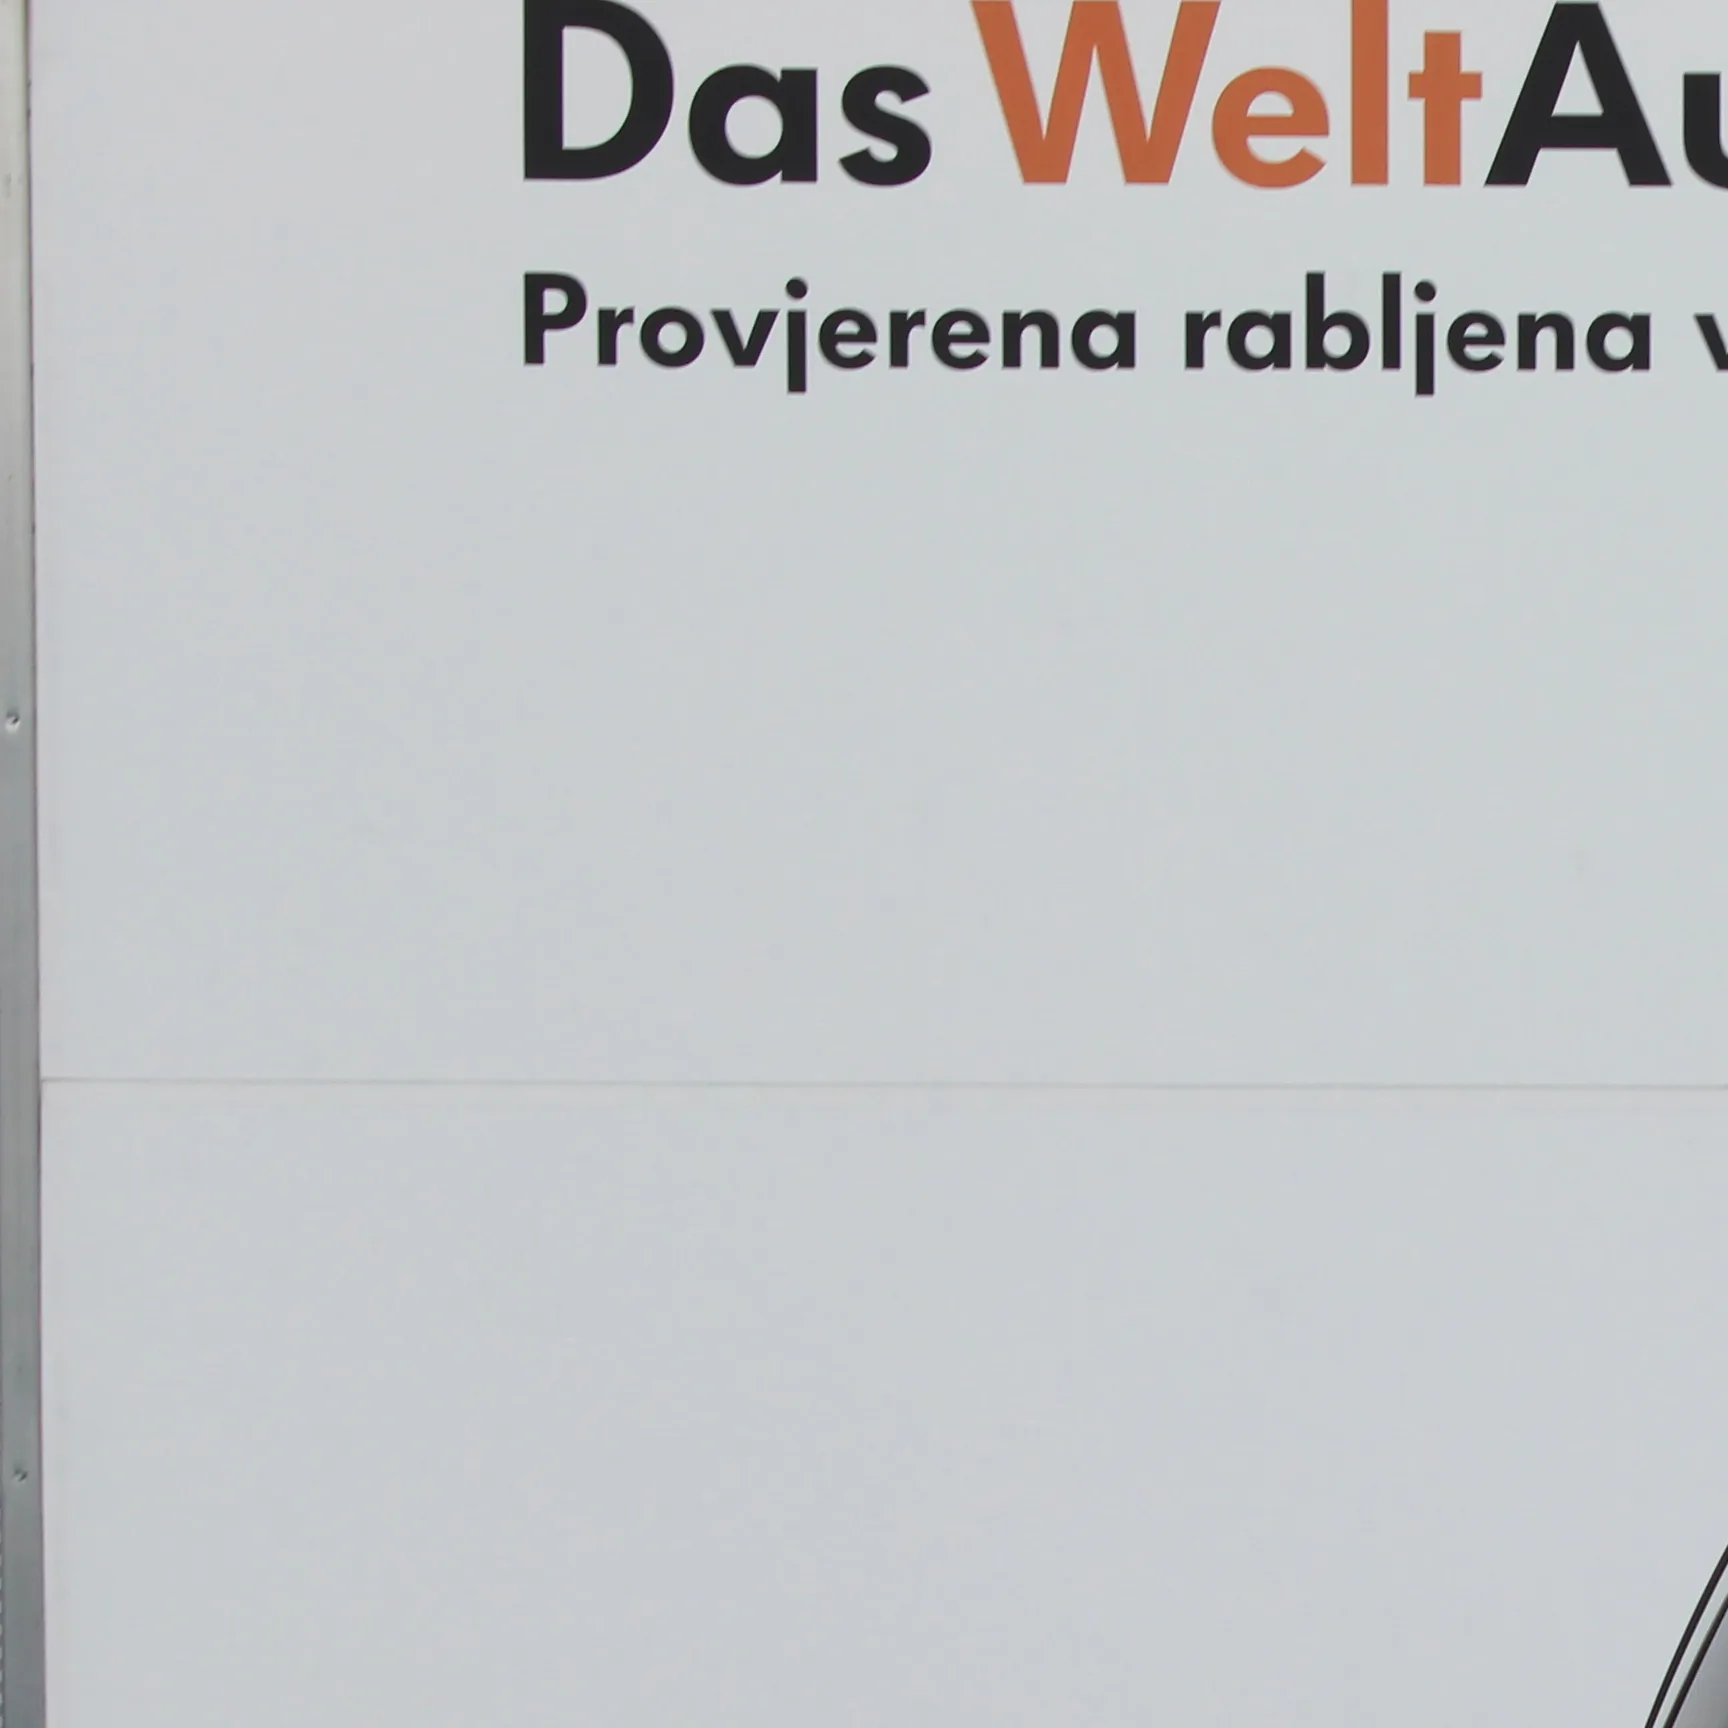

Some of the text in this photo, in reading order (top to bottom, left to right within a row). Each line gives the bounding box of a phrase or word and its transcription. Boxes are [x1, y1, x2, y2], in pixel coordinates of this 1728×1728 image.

[523, 0, 932, 187] Das
[523, 271, 1136, 394] Provjerena
[1184, 271, 1651, 396] rabljena
